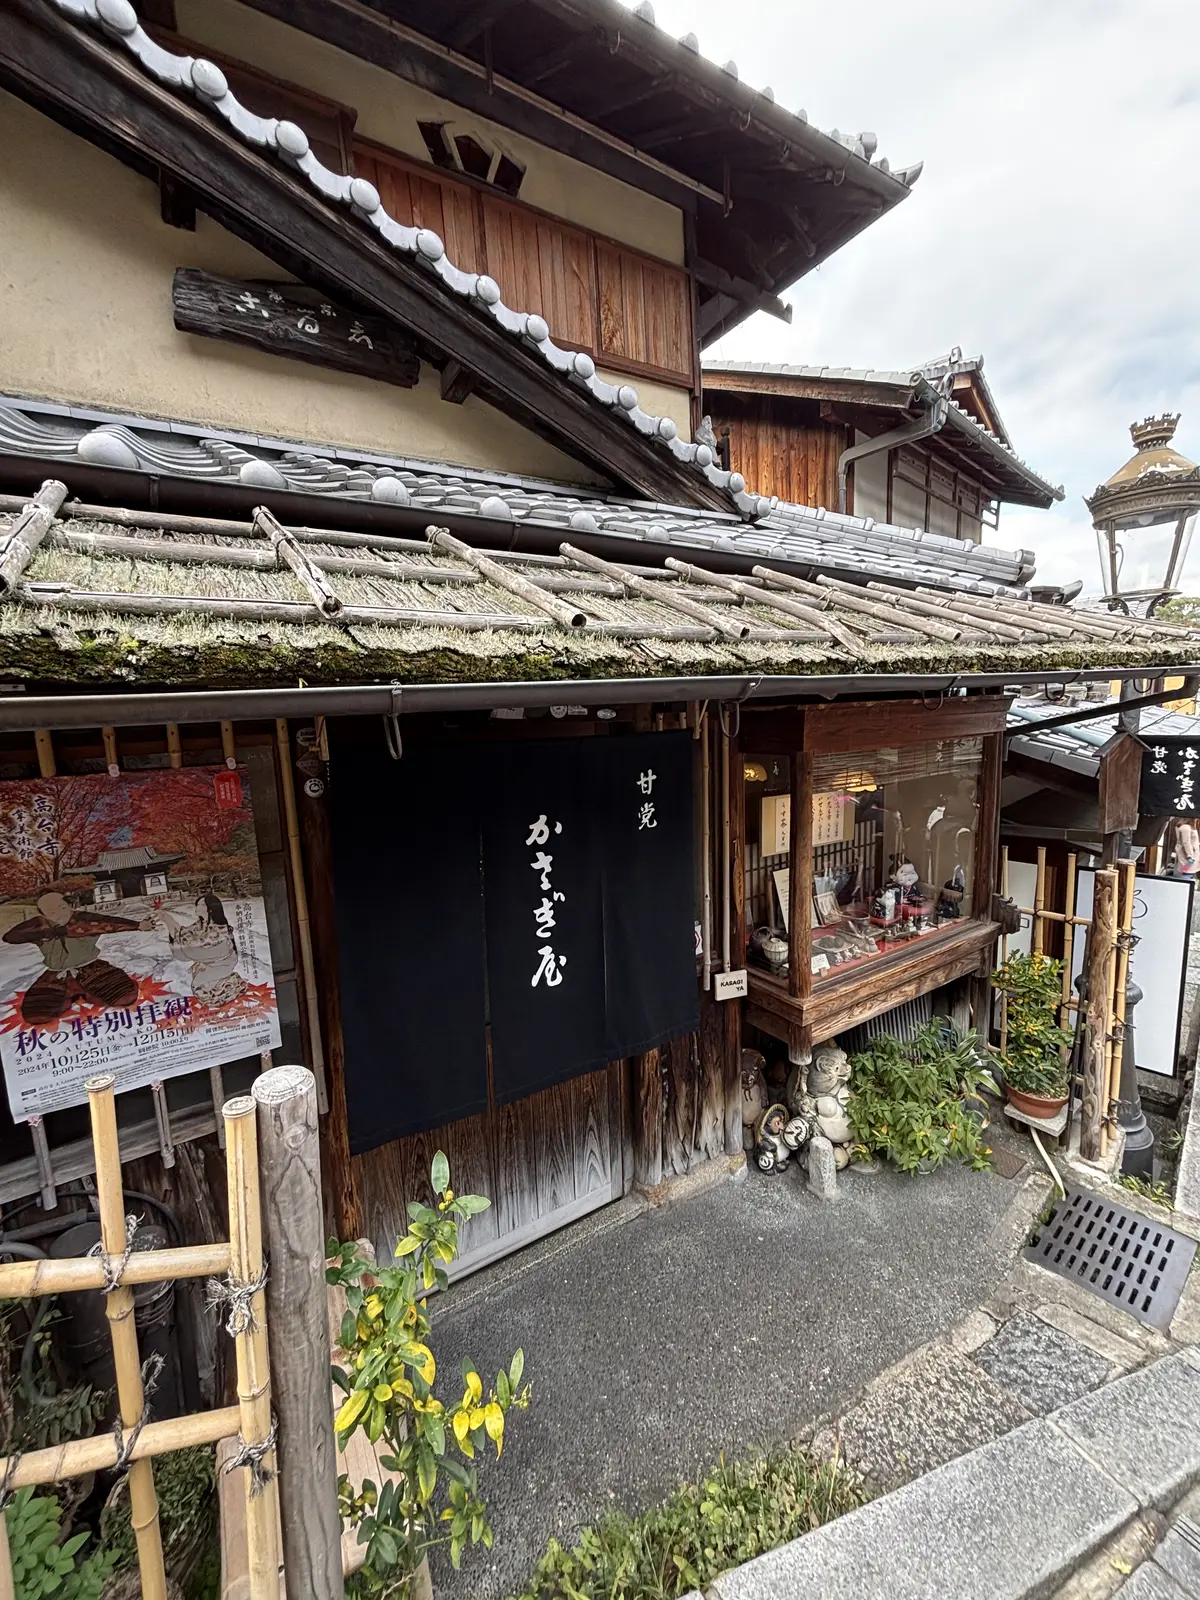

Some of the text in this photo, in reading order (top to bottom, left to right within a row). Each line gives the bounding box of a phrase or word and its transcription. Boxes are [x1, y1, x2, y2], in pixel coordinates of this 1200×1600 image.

[33, 795, 60, 856] 高台寺
[636, 769, 658, 831] 甘党
[525, 814, 567, 988] かさぎ屋
[721, 979, 744, 988] KASAGI
[14, 996, 193, 1056] 秋の特別拝観
[64, 1034, 126, 1053] AUTUMN
